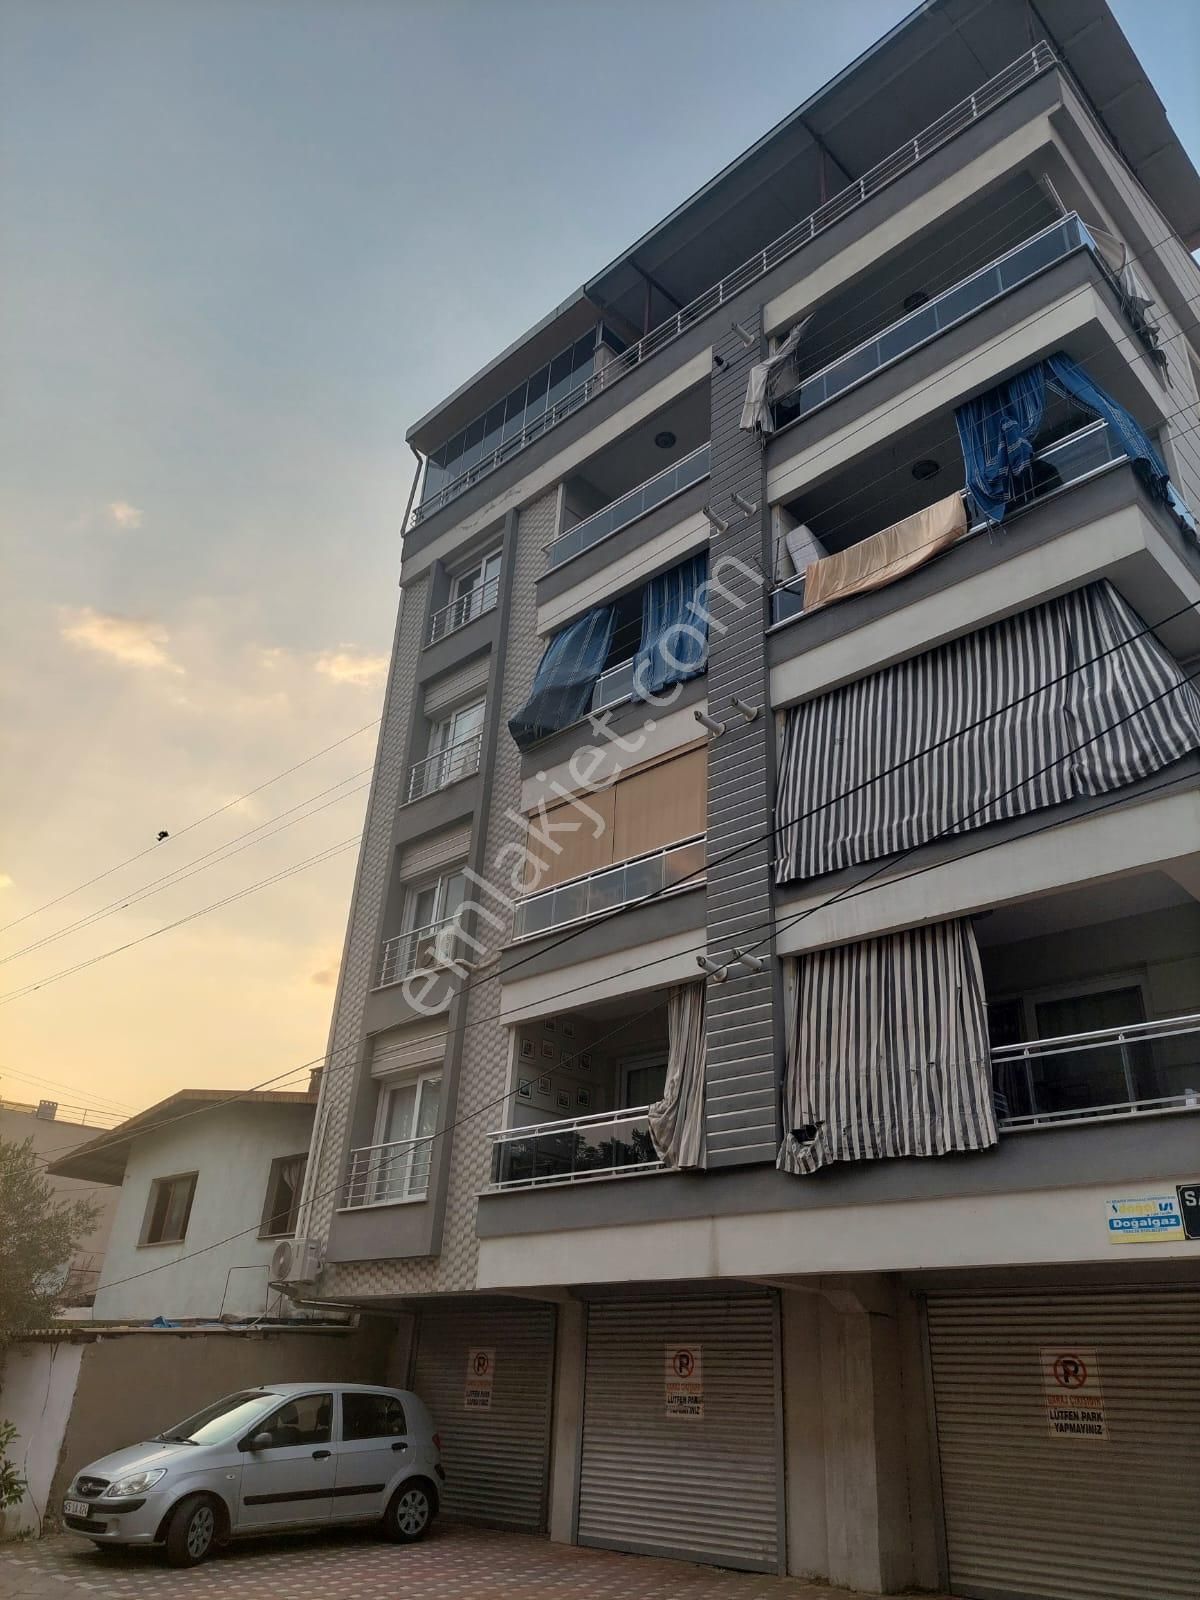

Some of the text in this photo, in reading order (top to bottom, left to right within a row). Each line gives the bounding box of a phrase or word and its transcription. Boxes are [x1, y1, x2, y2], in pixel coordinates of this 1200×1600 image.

[1184, 1190, 1200, 1207] S
[1112, 1218, 1177, 1228] Doğalgaz
[1049, 1408, 1104, 1422] LÜTFEN PARK
[1054, 1423, 1103, 1435] YAPMAYINIZ
